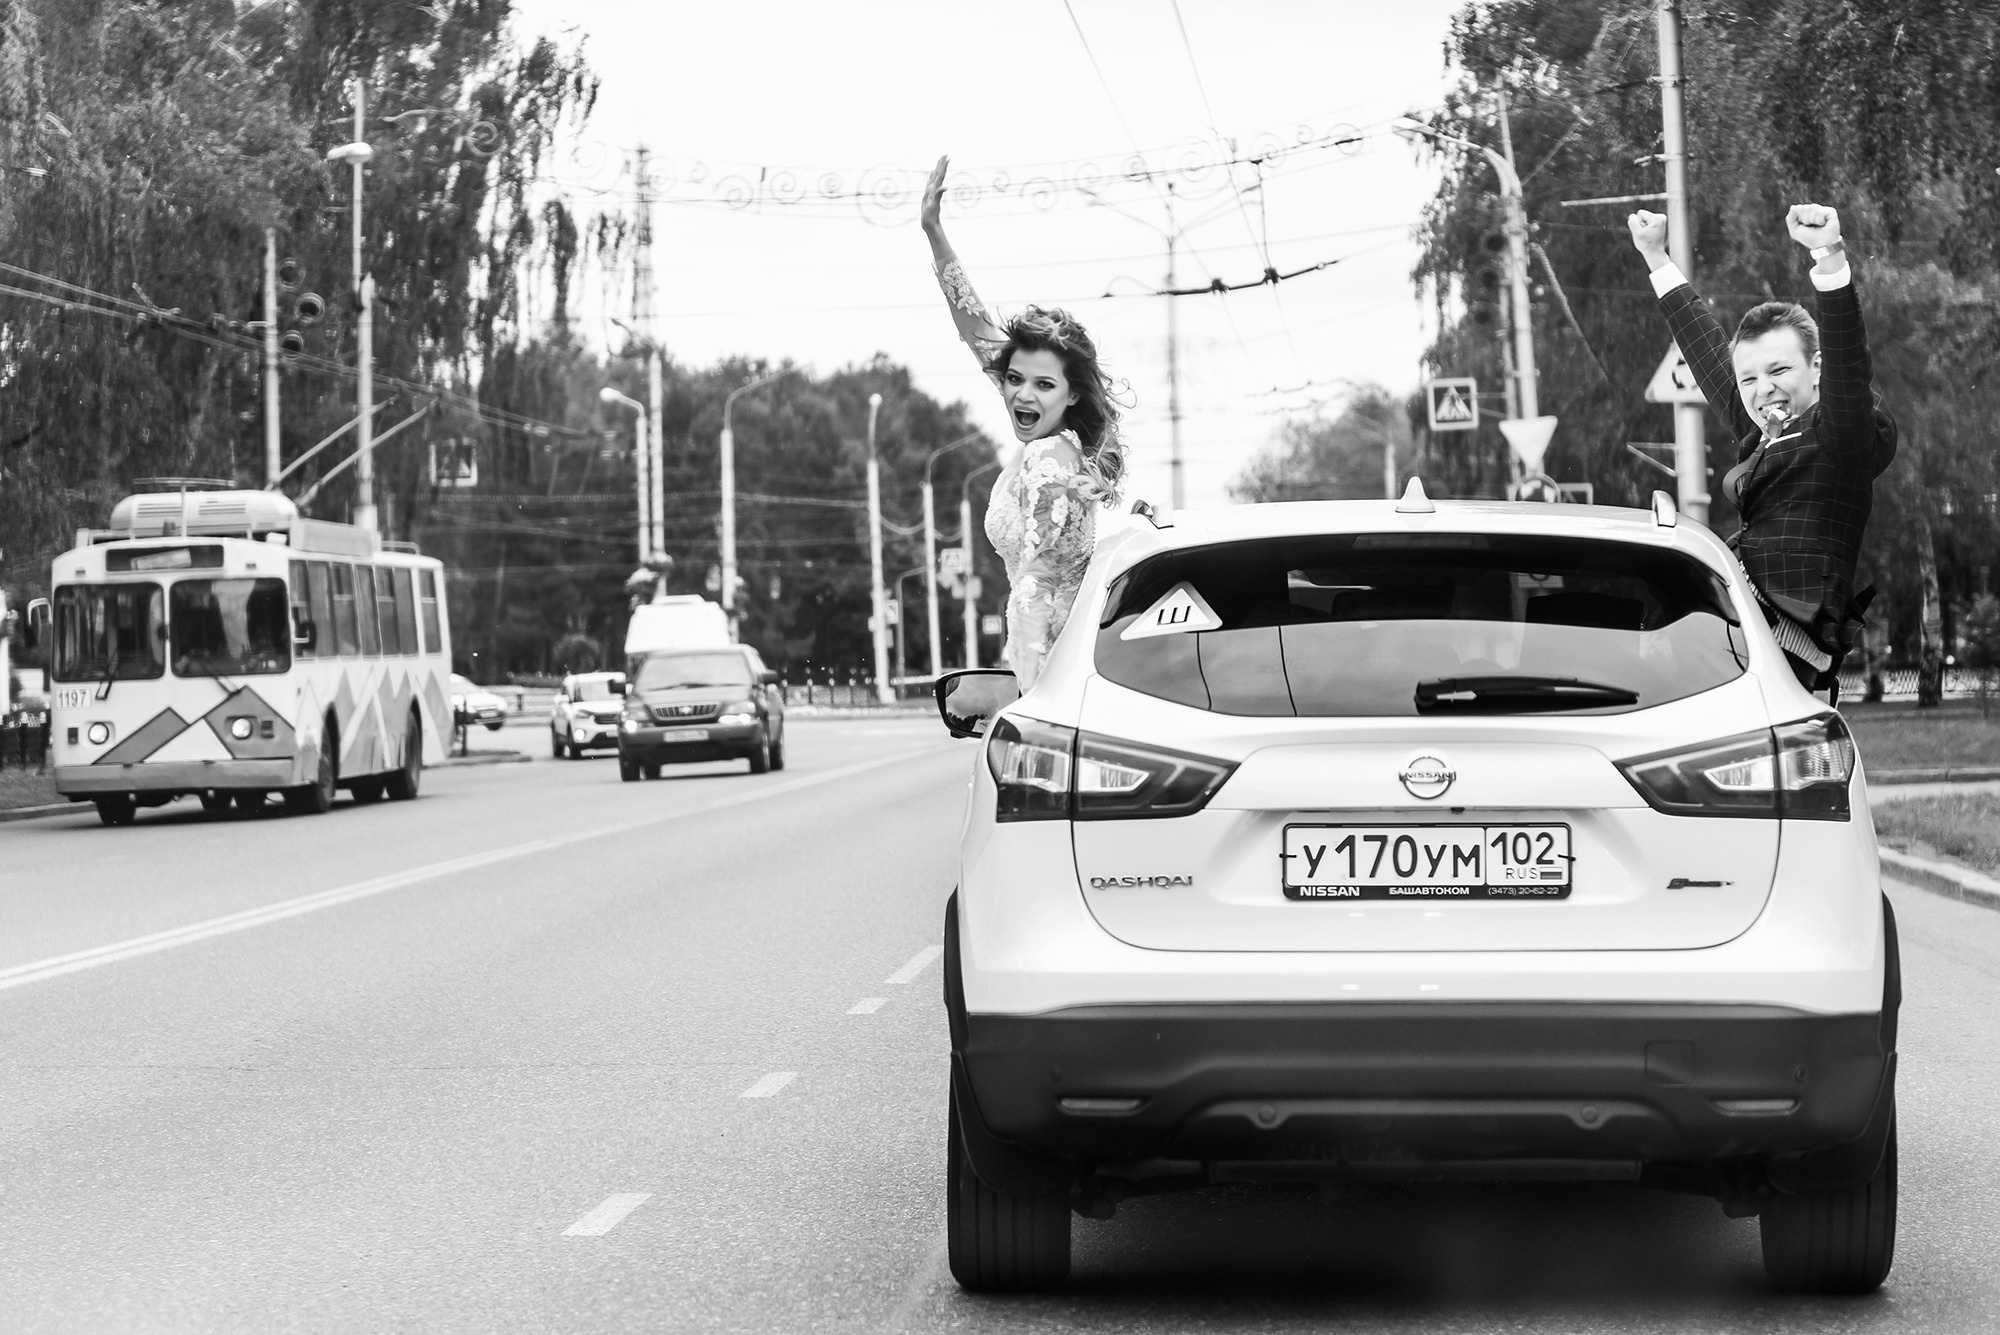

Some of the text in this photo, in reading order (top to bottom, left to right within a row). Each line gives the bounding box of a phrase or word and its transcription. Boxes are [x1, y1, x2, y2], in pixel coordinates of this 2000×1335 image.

[59, 689, 87, 707] 1197
[1490, 832, 1554, 865] 102
[1505, 867, 1538, 880] RUS
[1090, 874, 1193, 890] QASHQAI
[1300, 886, 1360, 897] NISSAN
[1388, 887, 1470, 895] БАШАВТОКОМ
[1488, 887, 1517, 896] (3473)
